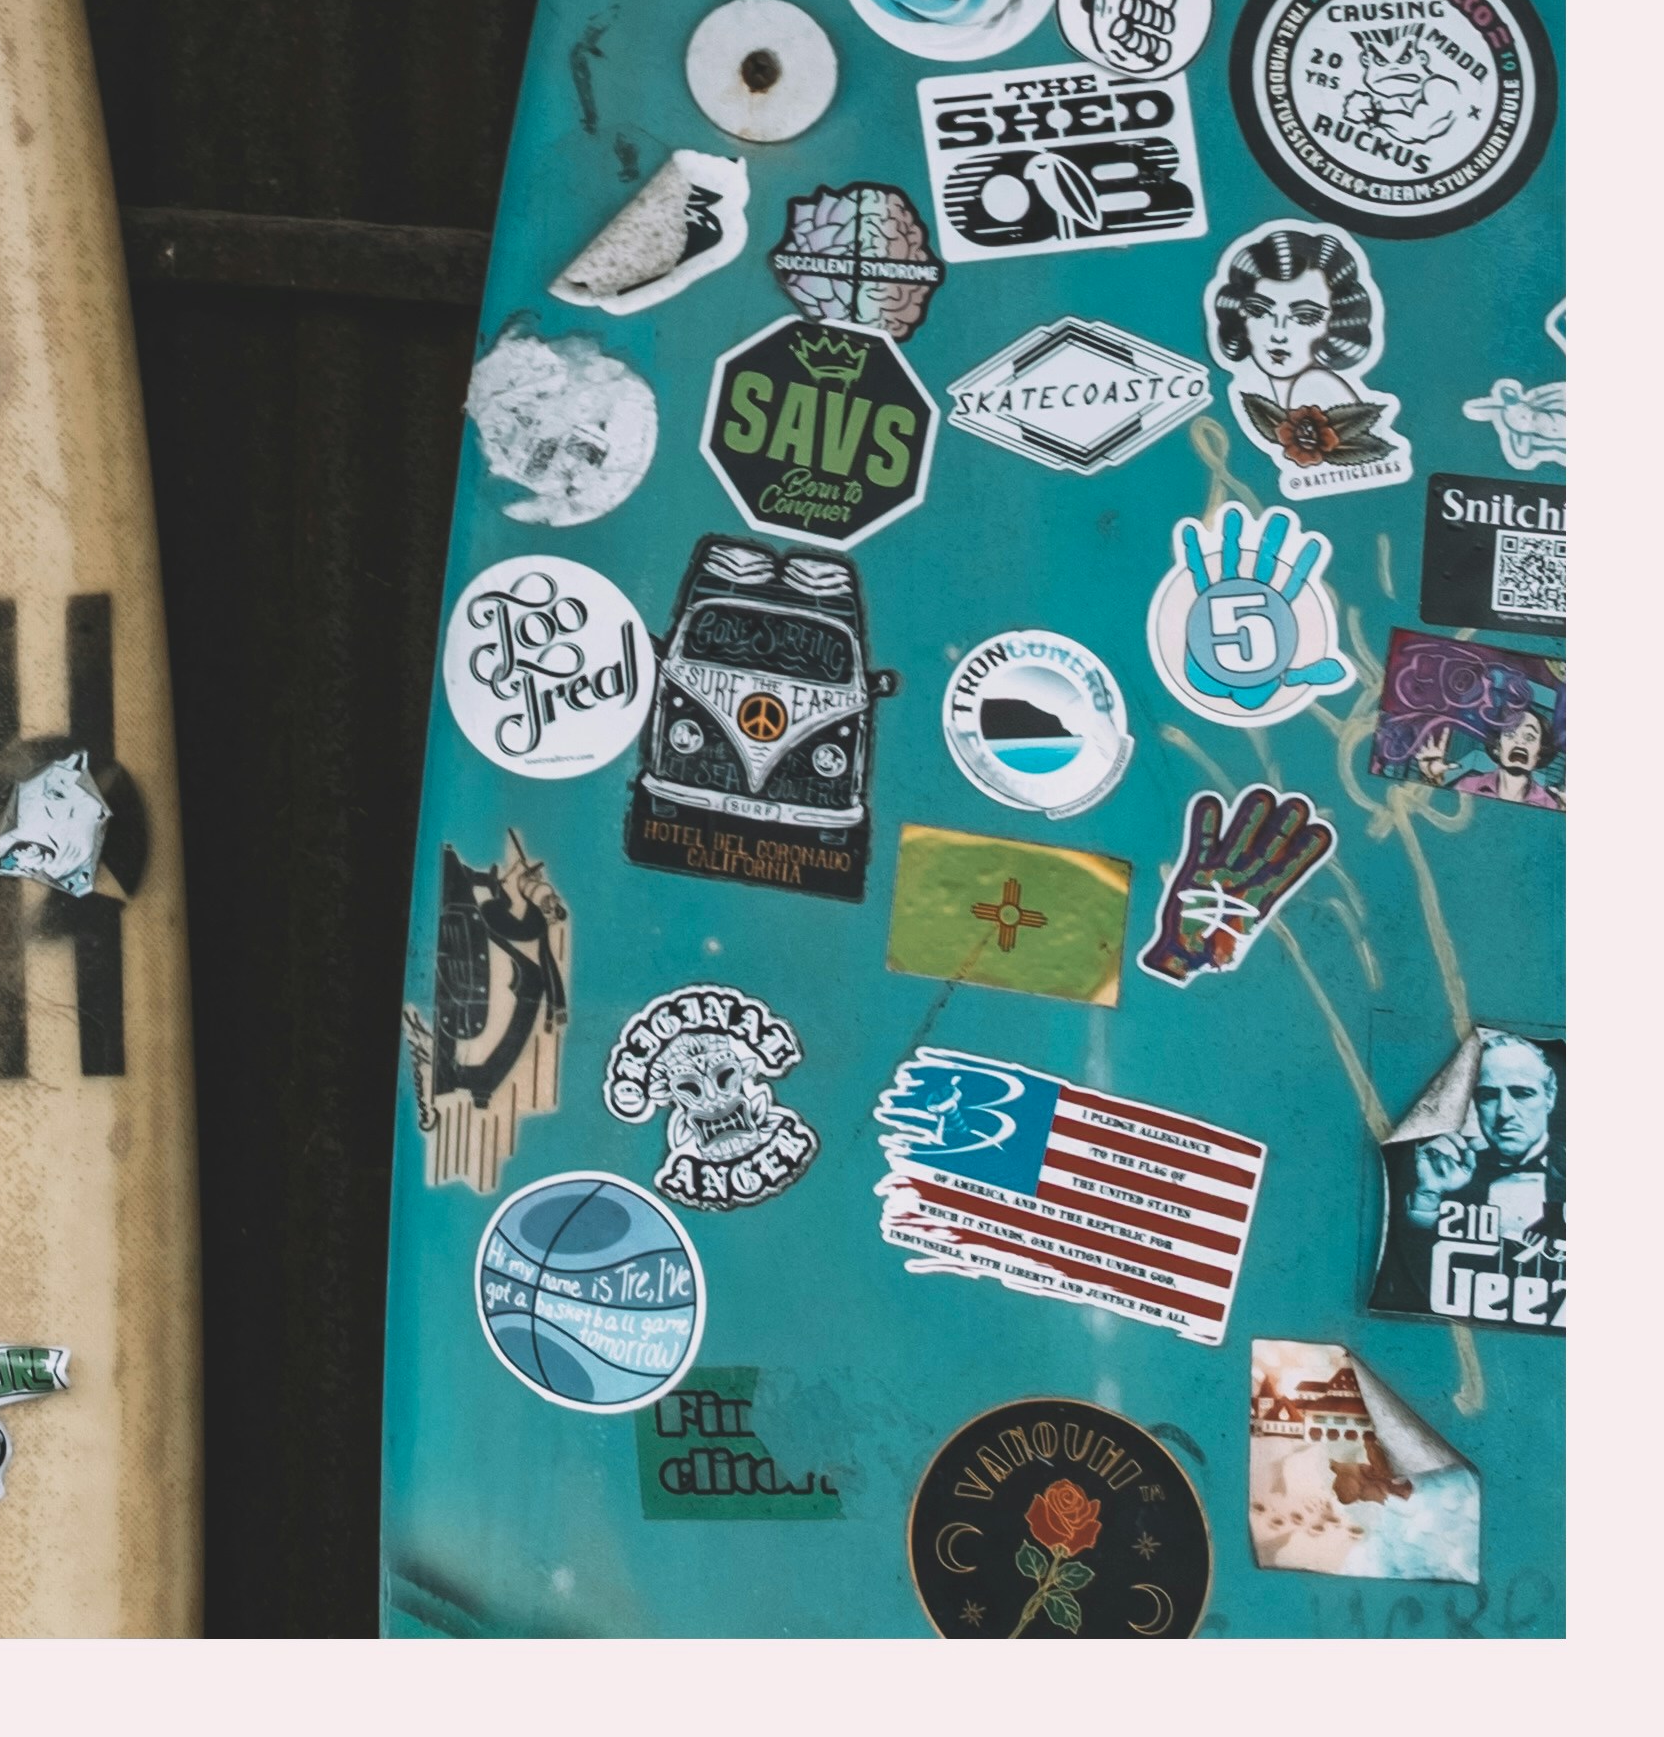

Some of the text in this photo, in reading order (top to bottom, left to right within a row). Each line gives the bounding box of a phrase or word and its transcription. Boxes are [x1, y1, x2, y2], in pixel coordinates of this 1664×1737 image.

[1327, 1, 1445, 23] CAUSING
[935, 89, 1174, 150] SHED
[1313, 114, 1432, 174] RUCKUS
[644, 820, 850, 872] HOTEL DEL CORONADO
[687, 848, 802, 884] CALIFORNIA
[1091, 1111, 1136, 1132] PLEDGE
[1140, 1126, 1212, 1155] ALLEGIANCE
[1072, 1177, 1191, 1219] THE UNITED STATES
[1438, 1200, 1500, 1242] 210
[487, 1237, 506, 1266] Hi
[509, 1253, 535, 1281] my
[539, 1274, 581, 1297] name
[592, 1268, 613, 1296] is
[487, 1281, 691, 1339] got a basketball game
